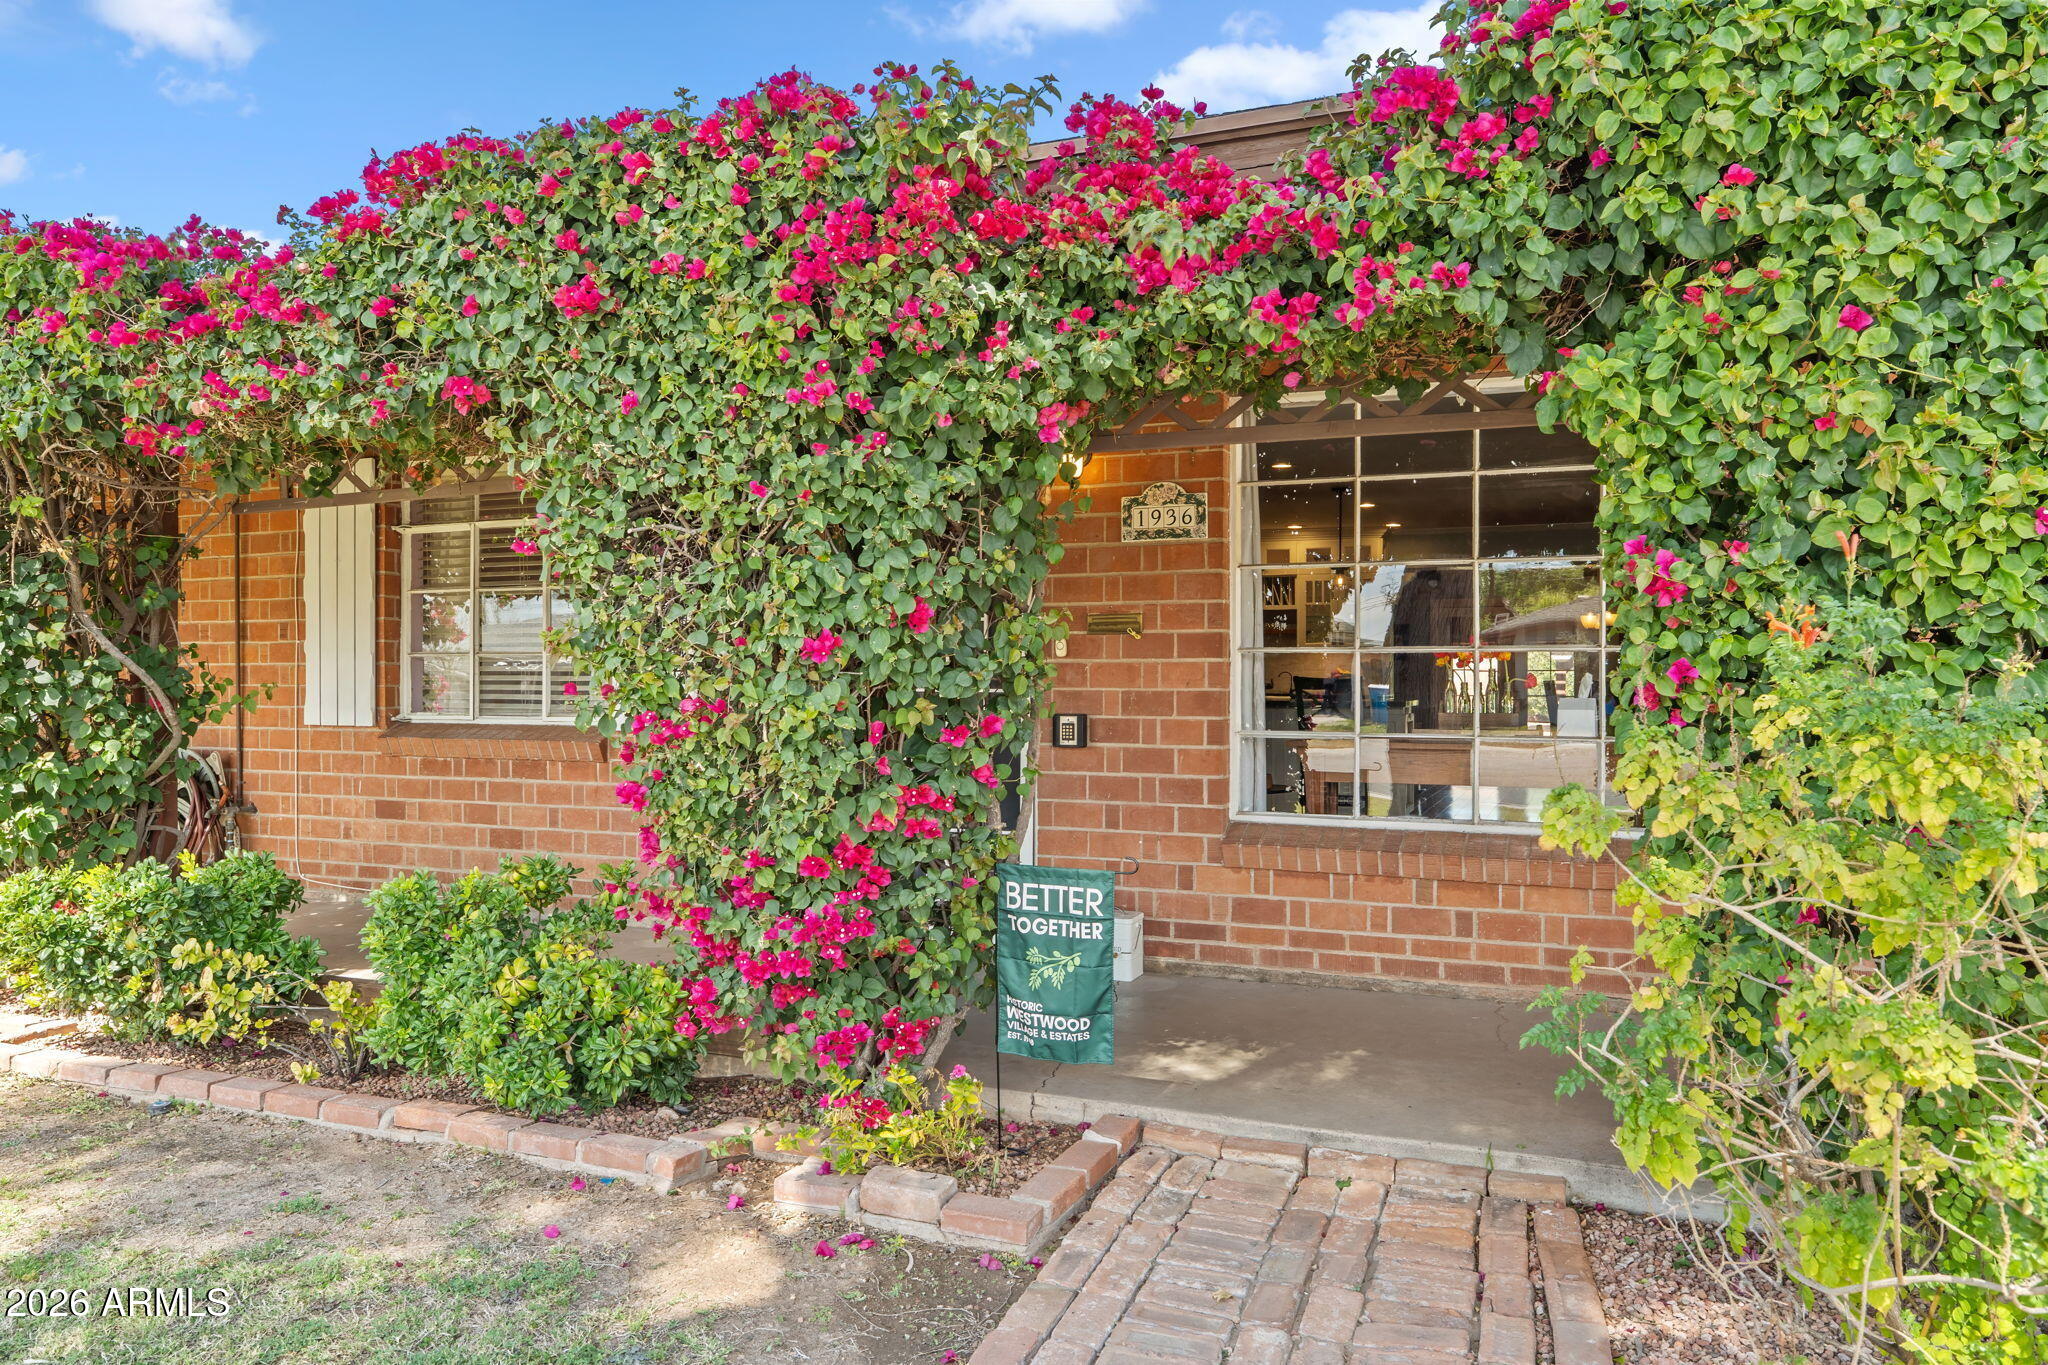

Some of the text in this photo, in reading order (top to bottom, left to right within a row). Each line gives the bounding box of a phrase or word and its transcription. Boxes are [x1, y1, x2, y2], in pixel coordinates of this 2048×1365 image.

[1137, 508, 1192, 526] 1936
[1006, 881, 1104, 917] BETTER
[1007, 914, 1103, 940] TOGETHER
[1007, 995, 1043, 1012] HSTORIC
[1006, 1005, 1090, 1031] WESTWOOD
[1006, 1020, 1090, 1042] VILLAGE & ESTATES
[1007, 1031, 1022, 1041] EST.
